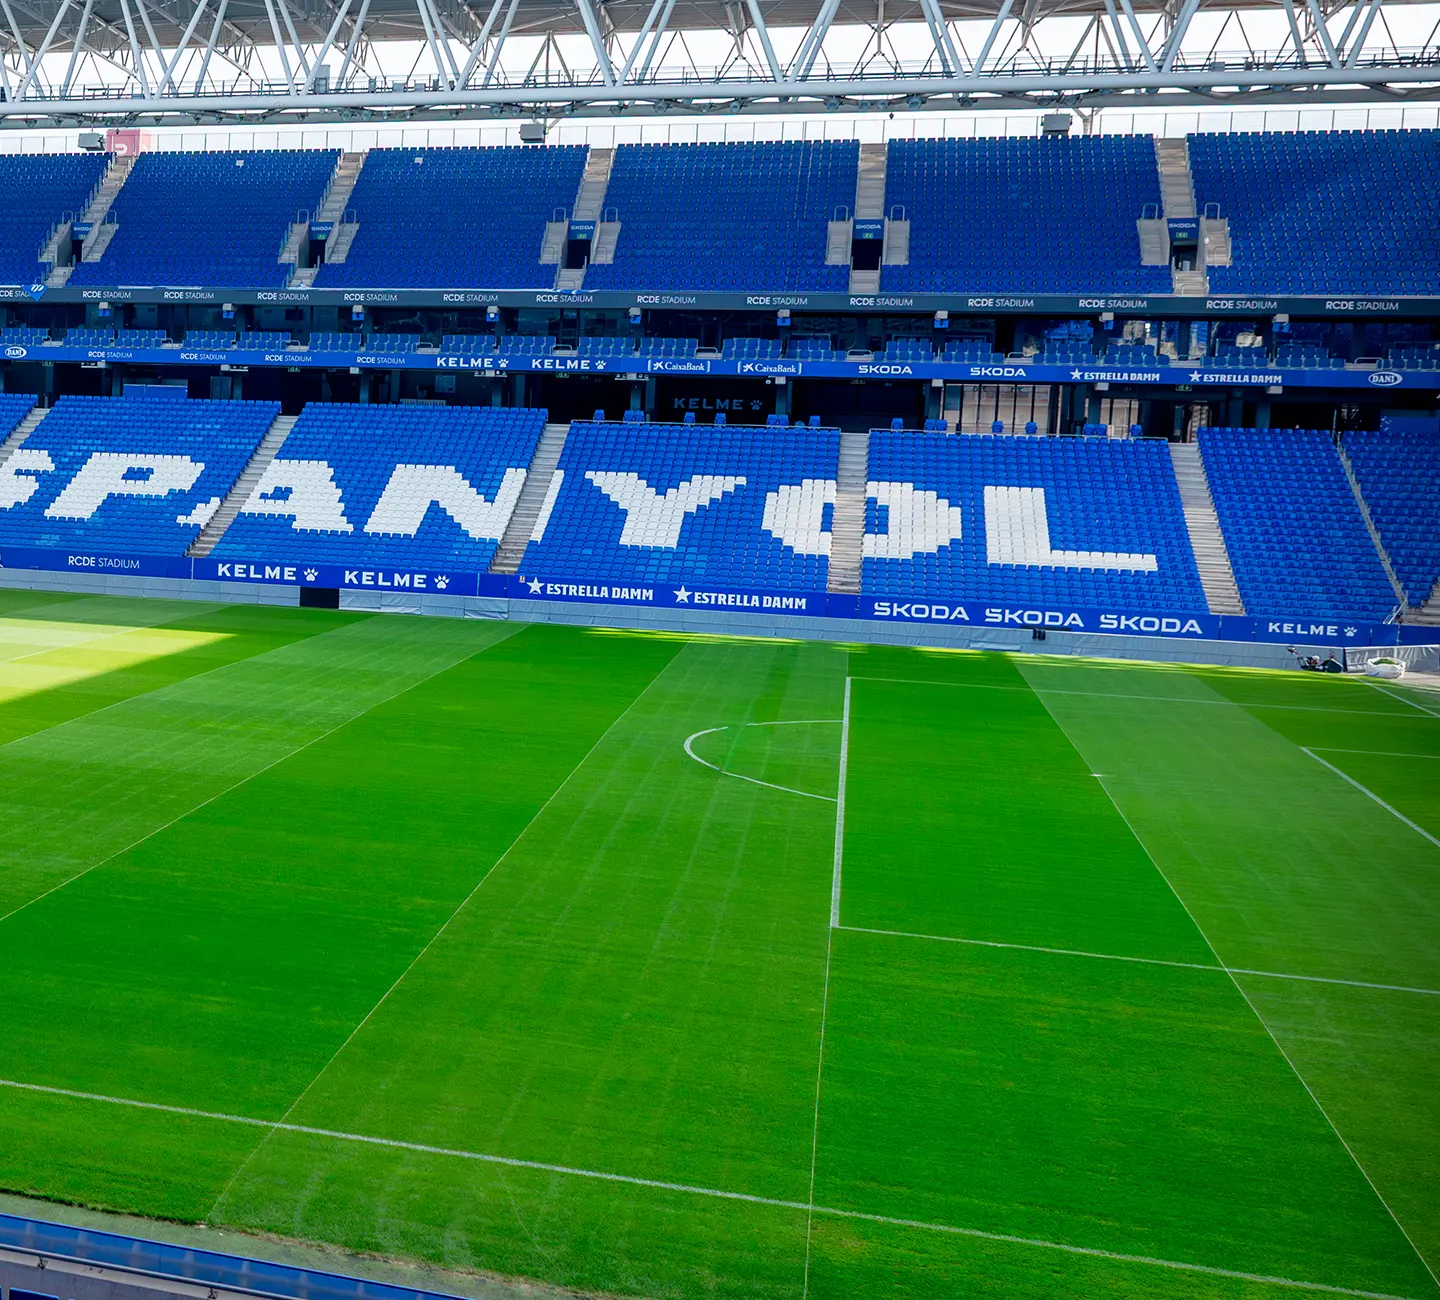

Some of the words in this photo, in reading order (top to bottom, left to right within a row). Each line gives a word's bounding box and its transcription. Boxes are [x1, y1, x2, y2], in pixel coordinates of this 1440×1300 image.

[258, 292, 276, 300] RCDE
[467, 294, 498, 302] STADIUM
[662, 296, 695, 304] STADIUM
[773, 297, 807, 305] STADIUM
[876, 298, 913, 306] STADIUM
[996, 299, 1034, 307] STADIUM
[1079, 299, 1105, 307] RCDE
[1107, 300, 1147, 308] STADIUM
[1206, 300, 1233, 308] RCDE
[1236, 301, 1277, 309] STADIUM
[1326, 301, 1354, 309] RCDE
[1357, 302, 1398, 310] STADIUM
[437, 357, 493, 367] KELME
[532, 359, 590, 369] KELME
[663, 362, 704, 370] CaixaBank
[755, 364, 796, 372] CaixaBank
[1084, 372, 1128, 380] ESTRELLA
[1130, 373, 1160, 381] DAMM
[1203, 374, 1247, 382] ESTRELLA
[1251, 375, 1282, 383] DAMM
[675, 398, 743, 409] KELME
[69, 556, 95, 566] RCDE
[98, 558, 139, 568] STADIUM
[218, 564, 296, 580] KELME
[345, 571, 426, 587] KELME
[547, 584, 608, 597] ESTRELLA
[612, 588, 653, 600] DAMM
[694, 592, 759, 606] ESTRELLA
[763, 596, 806, 609] DAMM
[1268, 623, 1338, 636] KELME
